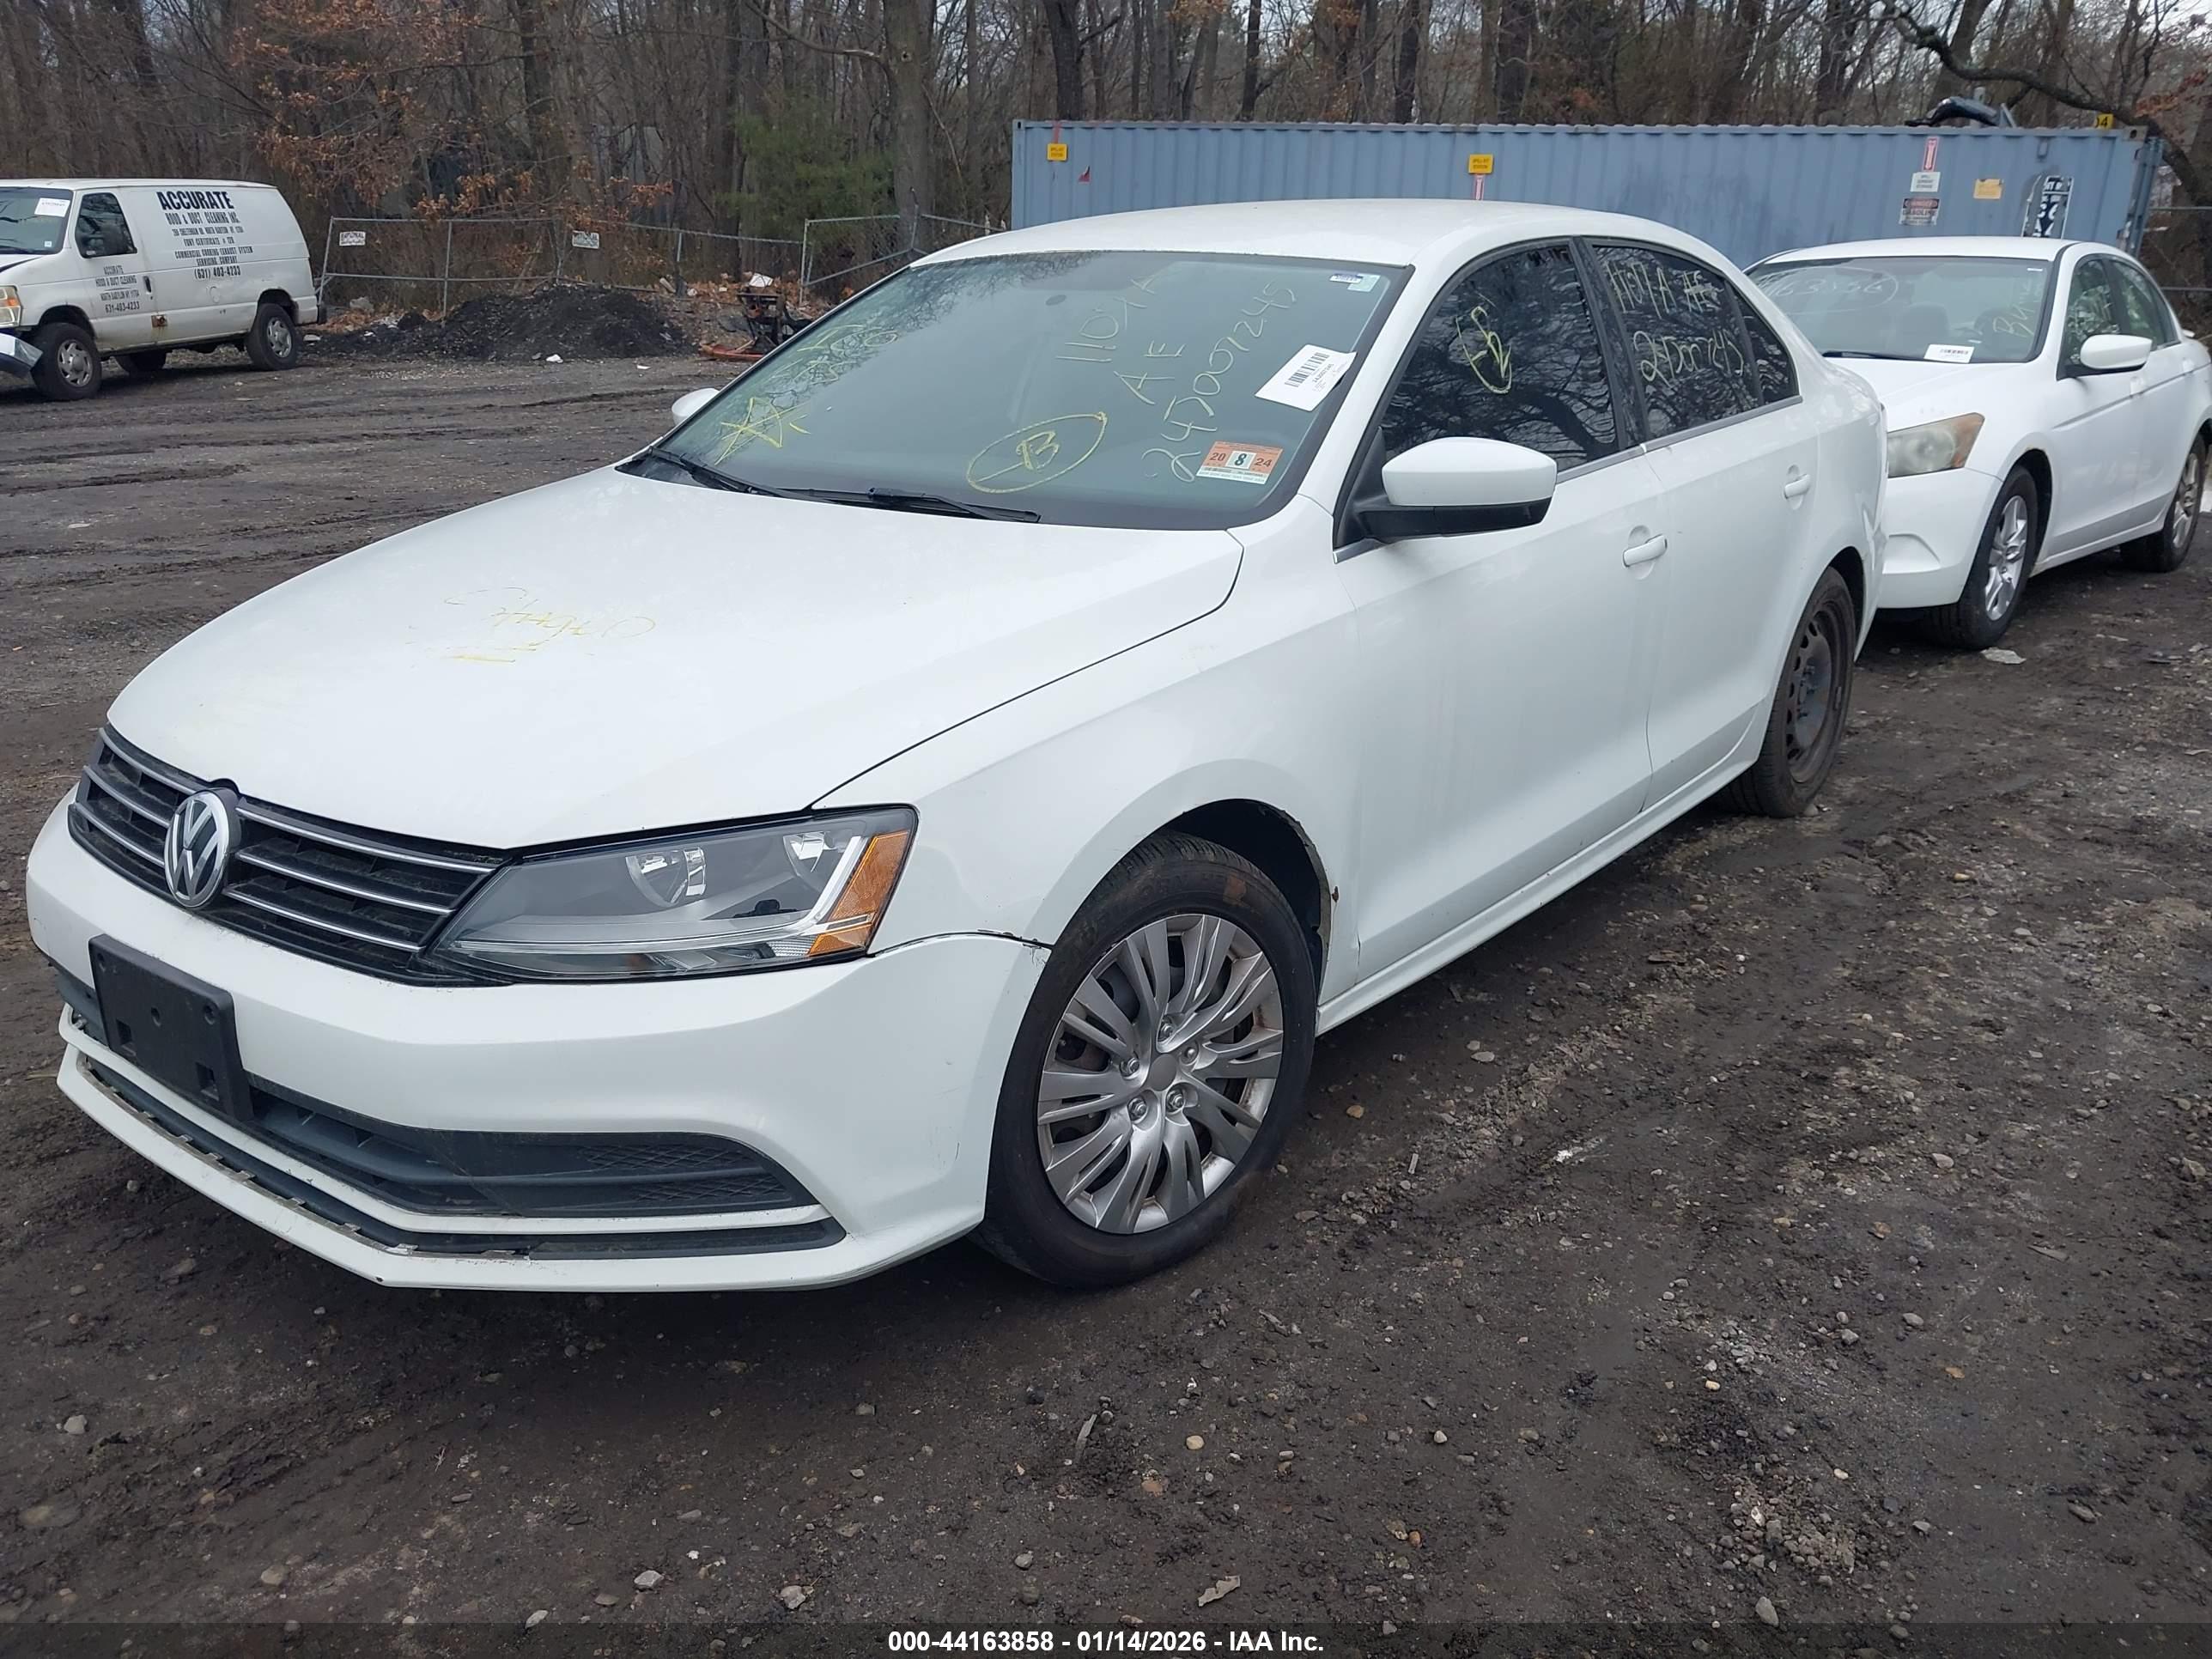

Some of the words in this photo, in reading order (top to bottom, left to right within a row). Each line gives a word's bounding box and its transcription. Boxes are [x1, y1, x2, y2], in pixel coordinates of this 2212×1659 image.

[156, 191, 234, 210] ACCURATE
[165, 212, 182, 225] HOOD
[181, 214, 188, 224] &
[187, 211, 204, 224] DUCT
[204, 211, 230, 224] CLEANING
[195, 237, 221, 246] CERTIFICATE
[174, 250, 202, 259] COMMERCIAL
[201, 248, 220, 257] COOKING
[219, 246, 238, 256] EXHAUST
[238, 246, 253, 255] SYSTEM
[218, 255, 238, 265] COMPANY
[194, 268, 211, 279] (631)
[213, 265, 241, 277] 403-4233
[119, 275, 137, 284] CLEANING
[1209, 452, 1227, 462] 20
[1234, 453, 1248, 466] 8
[1255, 457, 1273, 468] 24
